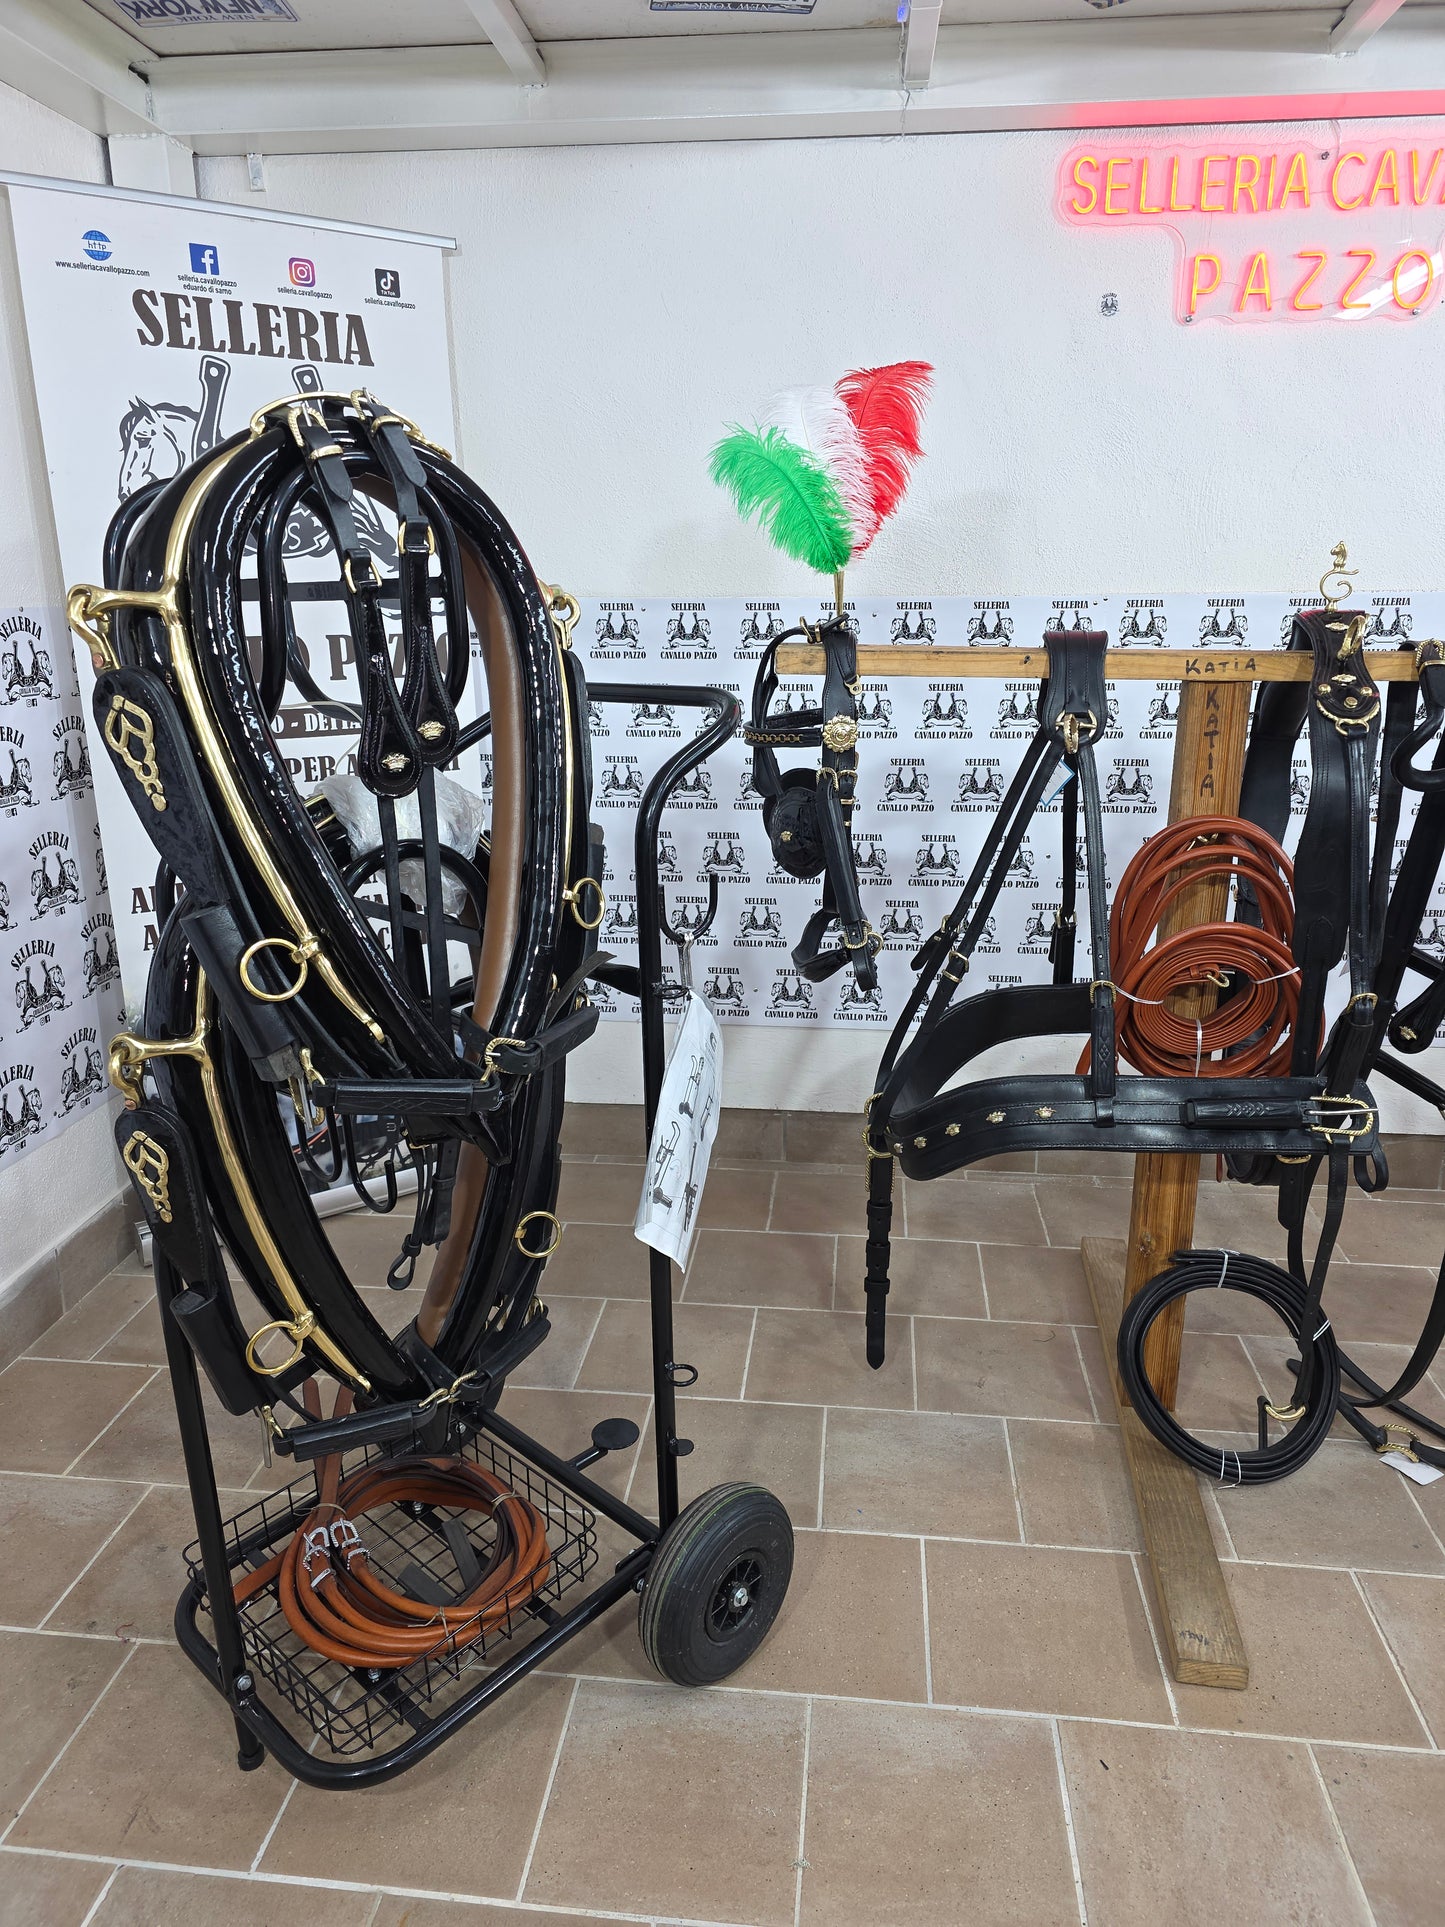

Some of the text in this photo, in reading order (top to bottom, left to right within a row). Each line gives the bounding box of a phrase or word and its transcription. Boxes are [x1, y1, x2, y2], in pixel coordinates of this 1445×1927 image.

[693, 2, 771, 11] NEW YORK
[176, 15, 215, 23] YORK
[1071, 148, 1445, 215] SELLERIA CAV
[55, 260, 150, 278] www.selleriacavallopazzo.com
[1189, 249, 1434, 314] PAZZO
[132, 289, 375, 368] SELLERIA
[600, 602, 634, 611] SELLERIA
[671, 602, 706, 611] SELLERIA
[745, 602, 780, 610] SELLERIA
[896, 602, 932, 610] SELLERIA
[974, 601, 1010, 610] SELLERIA
[1052, 600, 1088, 609] SELLERIA
[1126, 600, 1164, 608] SELLERIA
[1207, 599, 1245, 608] SELLERIA
[1289, 598, 1327, 607] SELLERIA
[1372, 598, 1411, 606] SELLERIA
[623, 652, 646, 660] PAZZO
[660, 652, 718, 660] CAVALLO PAZZO
[779, 684, 814, 692] SELLERIA
[862, 684, 888, 692] LLERIA
[928, 684, 964, 692] SELLERIA
[626, 729, 682, 738] CAVALLO PAZZO
[874, 731, 898, 740] PAZZO
[914, 731, 973, 740] CAVALLO PAZZO
[990, 731, 1022, 740] CAVALLO
[1104, 731, 1124, 740] AZZO
[1139, 731, 1172, 740] CAVALLO
[1200, 688, 1220, 798] KATIA
[605, 756, 638, 764] SELLERIA
[890, 758, 925, 766] SELLERIA
[965, 758, 1000, 766] SELLERIA
[1113, 758, 1150, 767] SELLERIA
[595, 800, 626, 808] CAVALLO
[695, 802, 718, 810] PAZZO
[877, 804, 934, 812] CAVALLO PAZZO
[950, 804, 982, 812] CAVALLO
[1132, 806, 1158, 814] PAZZO
[707, 832, 740, 840] SELLERIA
[922, 834, 956, 843] SELLERIA
[28, 831, 70, 860] SELLERIA
[661, 874, 684, 882] PAZZO
[728, 875, 750, 884] PAZZO
[766, 876, 821, 885] CAVALLO PAZZO
[869, 878, 892, 886] PAZZO
[908, 878, 965, 888] CAVALLO PAZZO
[1016, 880, 1040, 888] PAZZO
[675, 896, 708, 904] SELLERIA
[744, 897, 777, 905] SELLERIA
[886, 900, 919, 908] SELLERIA
[600, 936, 629, 944] CAVALLO
[696, 938, 718, 947] PAZZO
[734, 939, 788, 948] CAVALLO PAZZO
[978, 946, 1001, 954] PAZZO
[1018, 946, 1048, 954] CAVALLO
[10, 939, 56, 972] SELLERIA
[708, 966, 740, 975] SELLERIA
[988, 975, 1022, 984] SELLERIA
[727, 1008, 750, 1017] PAZZO
[764, 1010, 818, 1020] CAVALLO PAZZO
[833, 1012, 888, 1022] CAVALLO PAZZO
[60, 1027, 97, 1060] SELLERIA
